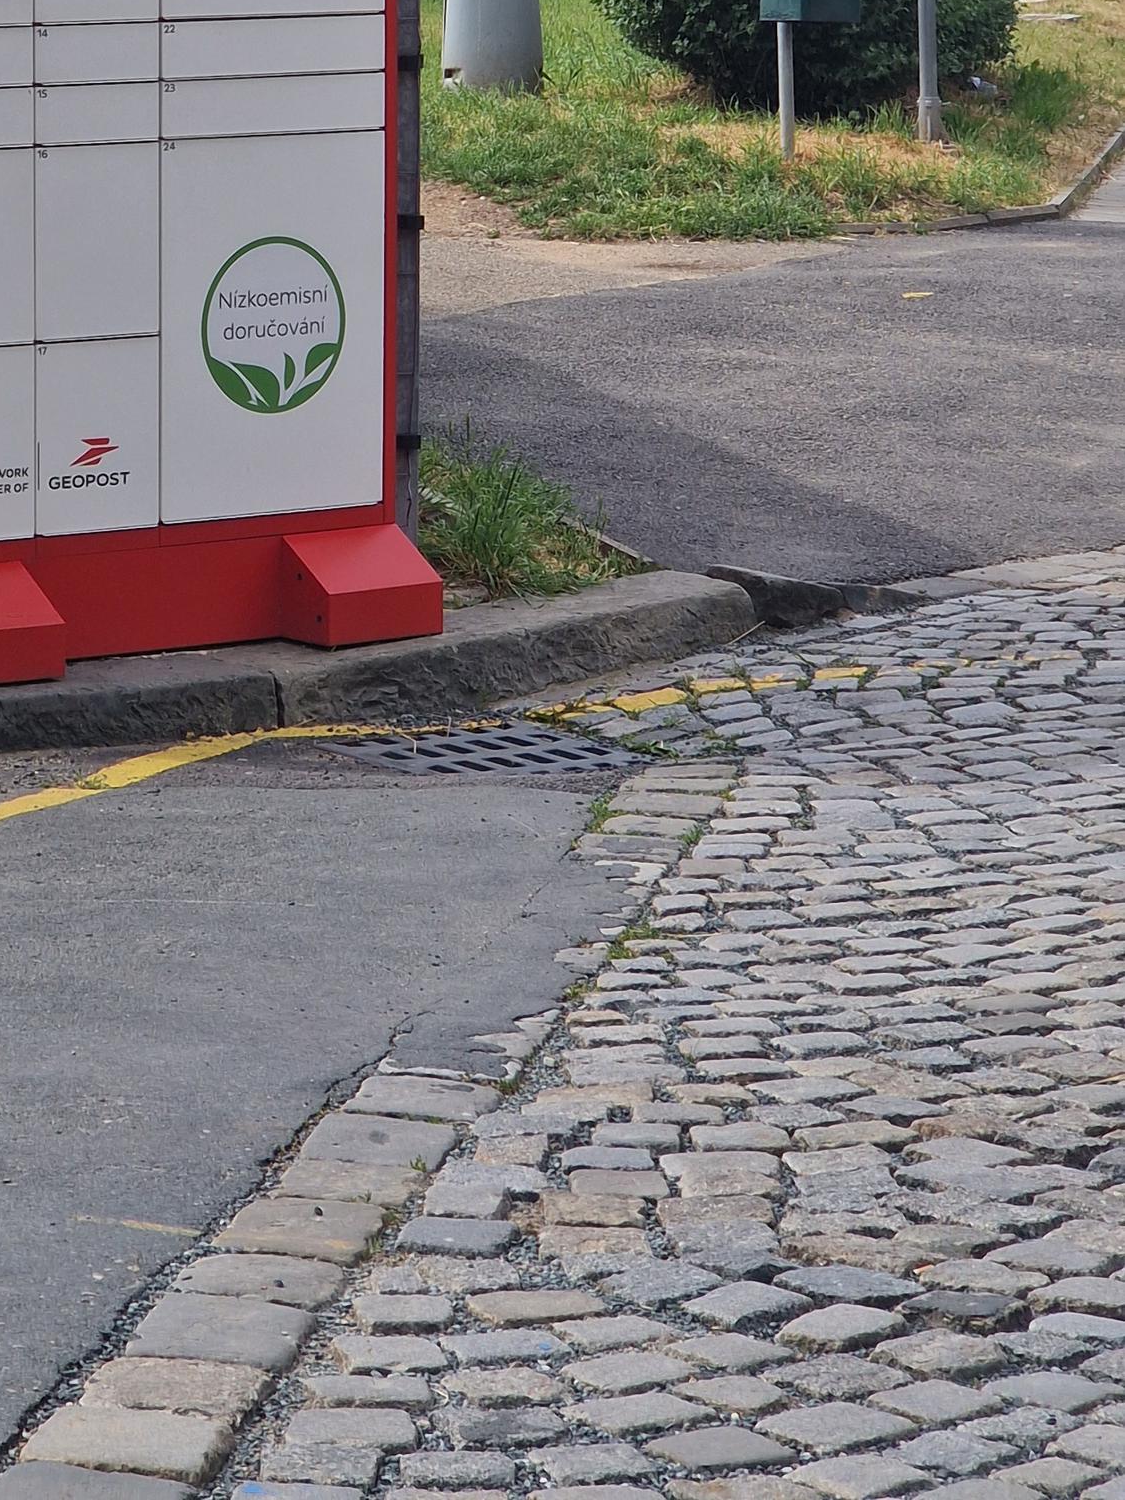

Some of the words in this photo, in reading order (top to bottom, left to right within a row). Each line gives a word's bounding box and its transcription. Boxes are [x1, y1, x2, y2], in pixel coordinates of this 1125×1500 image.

[37, 29, 48, 38] 14
[163, 25, 175, 33] 22
[163, 84, 175, 93] 23
[37, 89, 48, 98] 15
[163, 142, 175, 151] 24
[37, 150, 48, 159] 16
[219, 284, 327, 309] Nízkoemisní
[223, 316, 325, 340] doručování
[37, 346, 47, 356] 17
[48, 471, 131, 490] GEOPOST
[13, 483, 29, 493] OF
